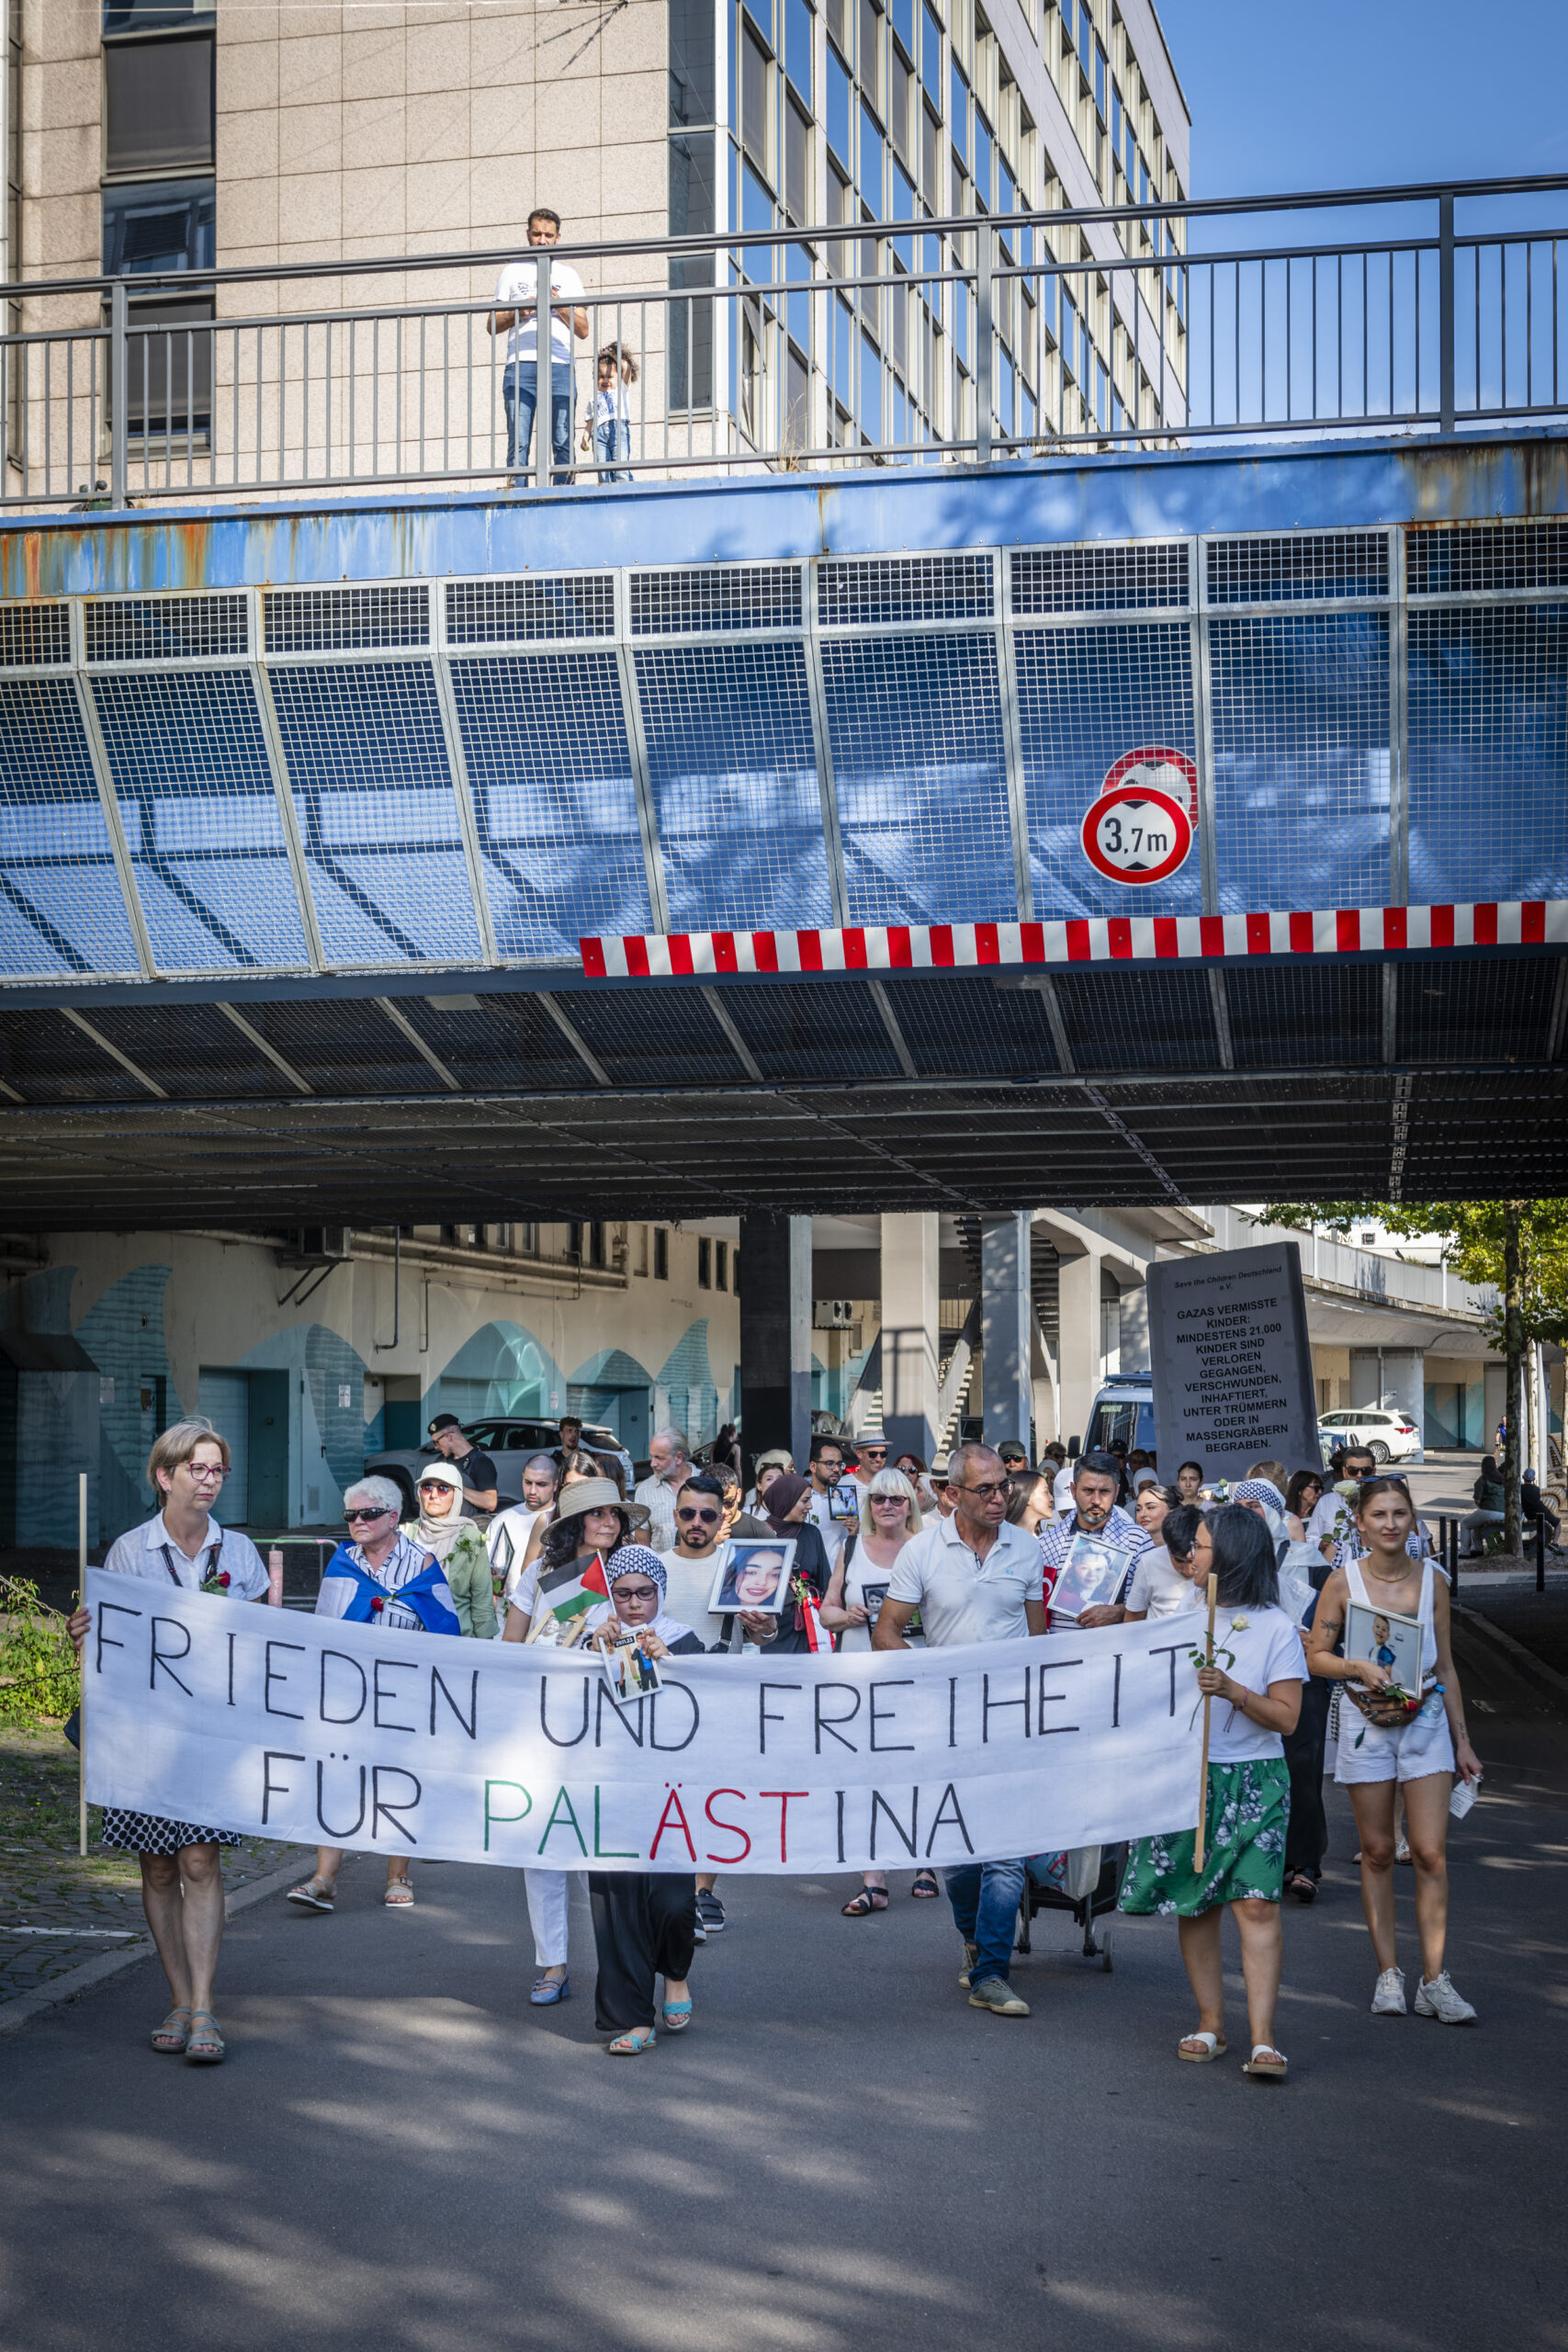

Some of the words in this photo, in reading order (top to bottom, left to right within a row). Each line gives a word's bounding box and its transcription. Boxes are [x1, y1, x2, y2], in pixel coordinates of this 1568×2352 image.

[1207, 1273, 1236, 1283] Children
[1238, 1266, 1281, 1279] Deutschland
[1177, 1307, 1214, 1319] GAZAS
[1217, 1298, 1277, 1315] VERMISSTE
[1207, 1316, 1250, 1329] KINDER:
[1177, 1328, 1247, 1343] MINDESTENS
[1250, 1323, 1281, 1335] 21.000
[1196, 1342, 1237, 1354] KINDER
[1240, 1339, 1265, 1349] SIND
[1201, 1351, 1261, 1366] VERLOREN
[1200, 1364, 1266, 1378] GEGANGEN,
[1185, 1374, 1281, 1392] VERSCHWUNDEN,
[1201, 1389, 1268, 1403] INHAFTIERT,
[1183, 1406, 1221, 1417] UNTER
[1224, 1398, 1287, 1413] TRÜMMERN
[1214, 1416, 1246, 1427] ODER
[1249, 1415, 1259, 1424] IN
[1187, 1424, 1288, 1441] MASSENGRÄBERN
[1205, 1439, 1271, 1453] BEGRABEN.
[96, 1600, 480, 1740] FRIEDEN
[540, 1675, 701, 1752] UND
[758, 1642, 1197, 1755] FREIHEIT
[261, 1750, 423, 1845] FÜR
[482, 1780, 976, 1864] PALÄSTINA
